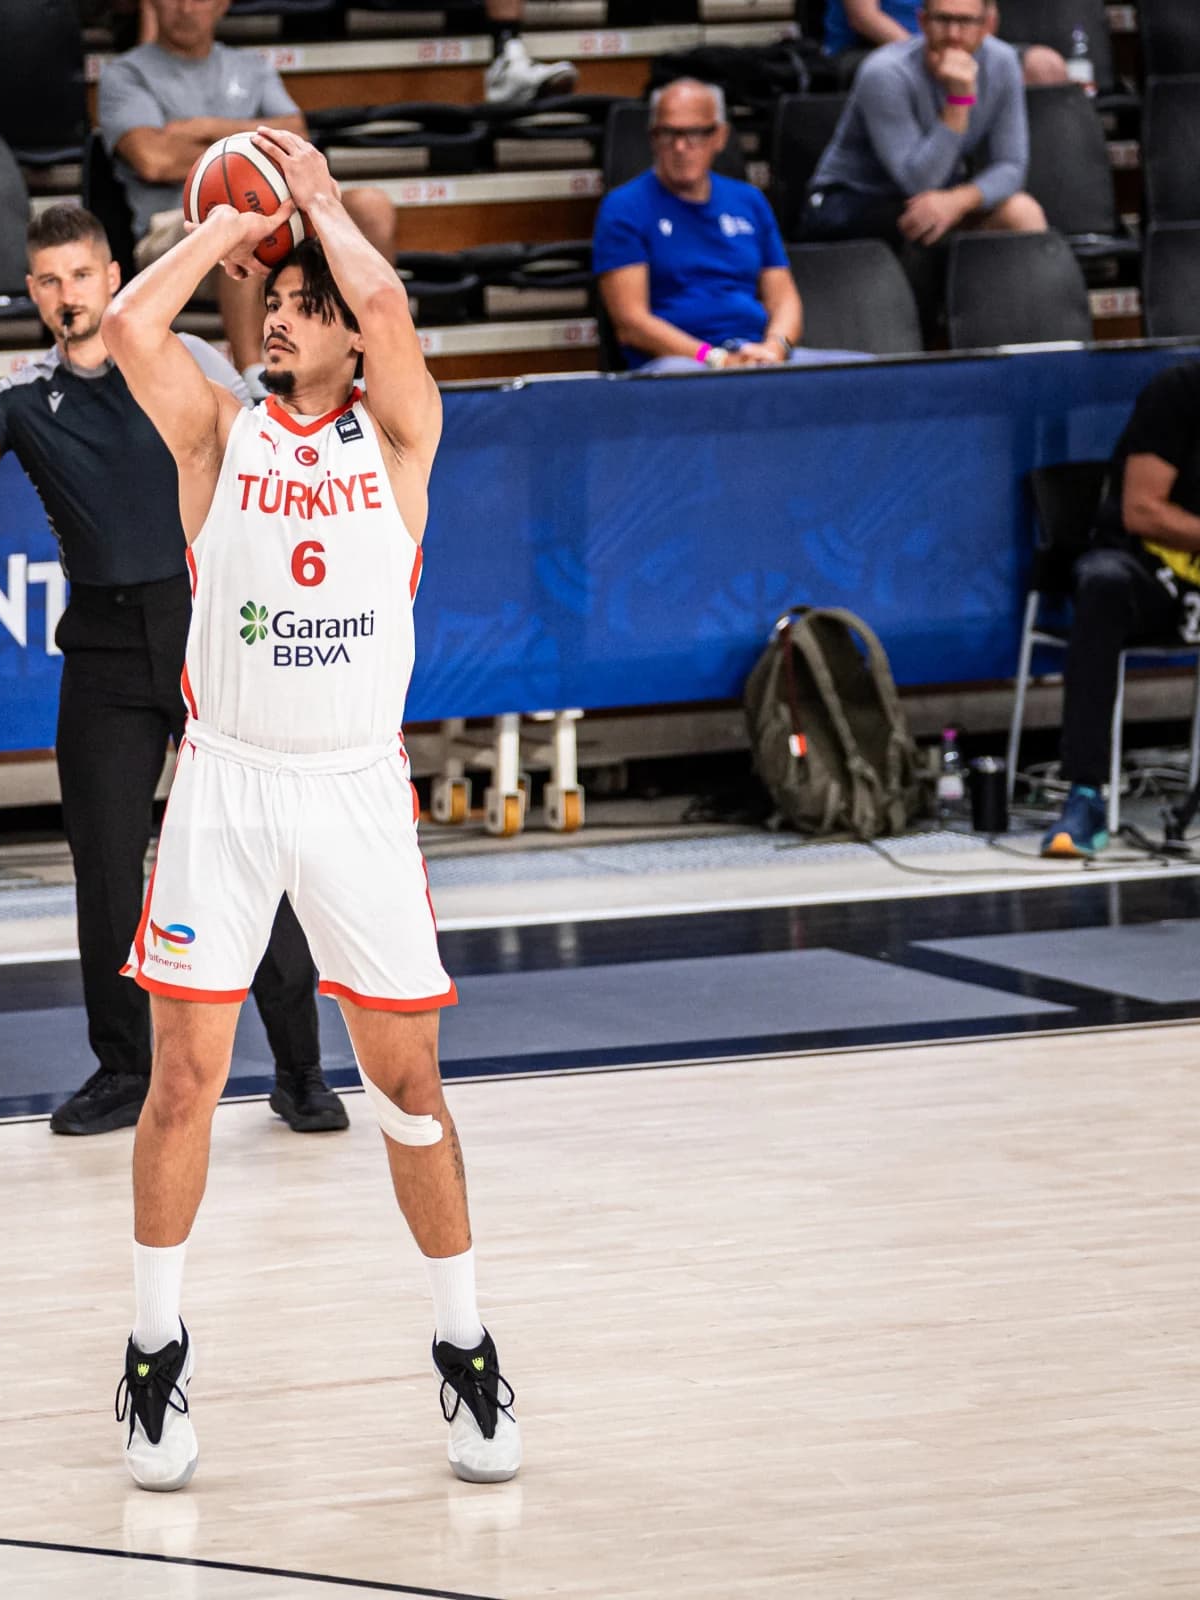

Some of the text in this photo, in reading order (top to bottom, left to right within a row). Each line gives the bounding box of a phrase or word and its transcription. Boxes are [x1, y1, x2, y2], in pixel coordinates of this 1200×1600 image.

[237, 469, 382, 520] TÜRKİYE
[291, 540, 327, 587] 6
[272, 610, 375, 639] Garanti
[273, 642, 350, 667] BBVA
